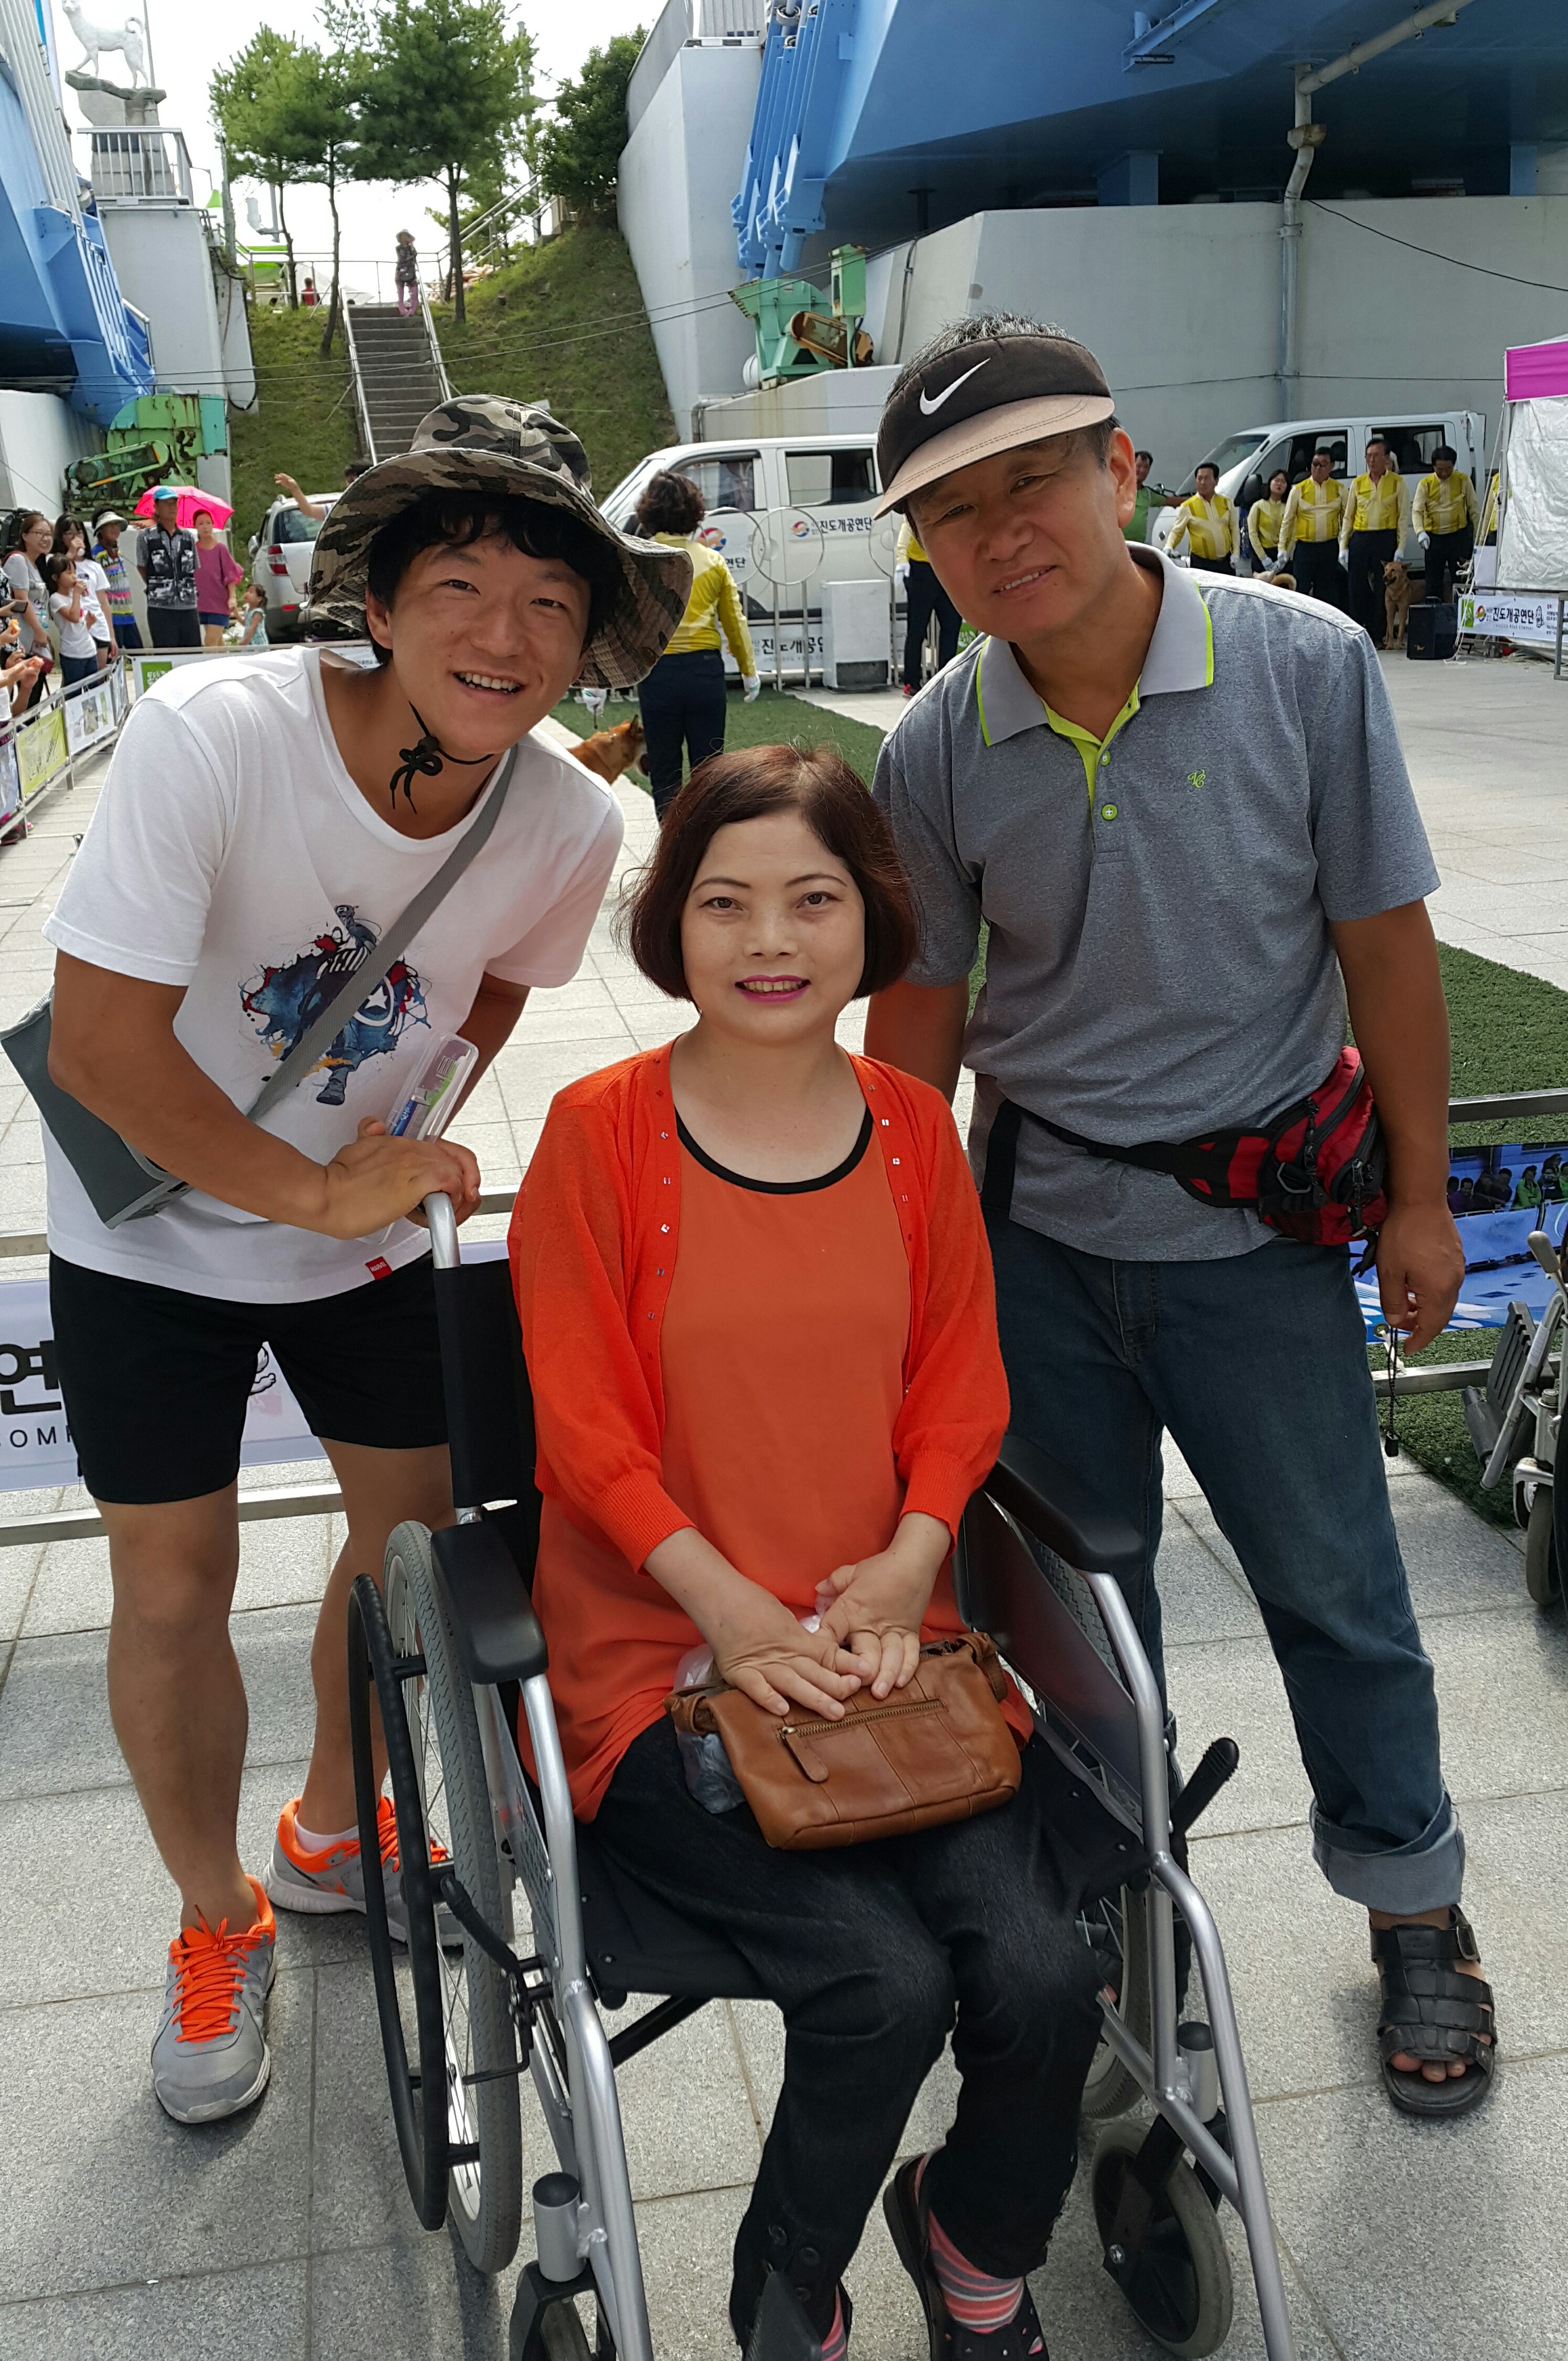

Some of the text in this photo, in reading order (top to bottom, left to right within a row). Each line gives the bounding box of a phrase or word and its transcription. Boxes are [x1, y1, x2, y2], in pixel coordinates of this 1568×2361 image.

[819, 517, 873, 534] 진도개공연단
[1492, 607, 1534, 624] 진도개공연단
[369, 1261, 387, 1272] MARVEL
